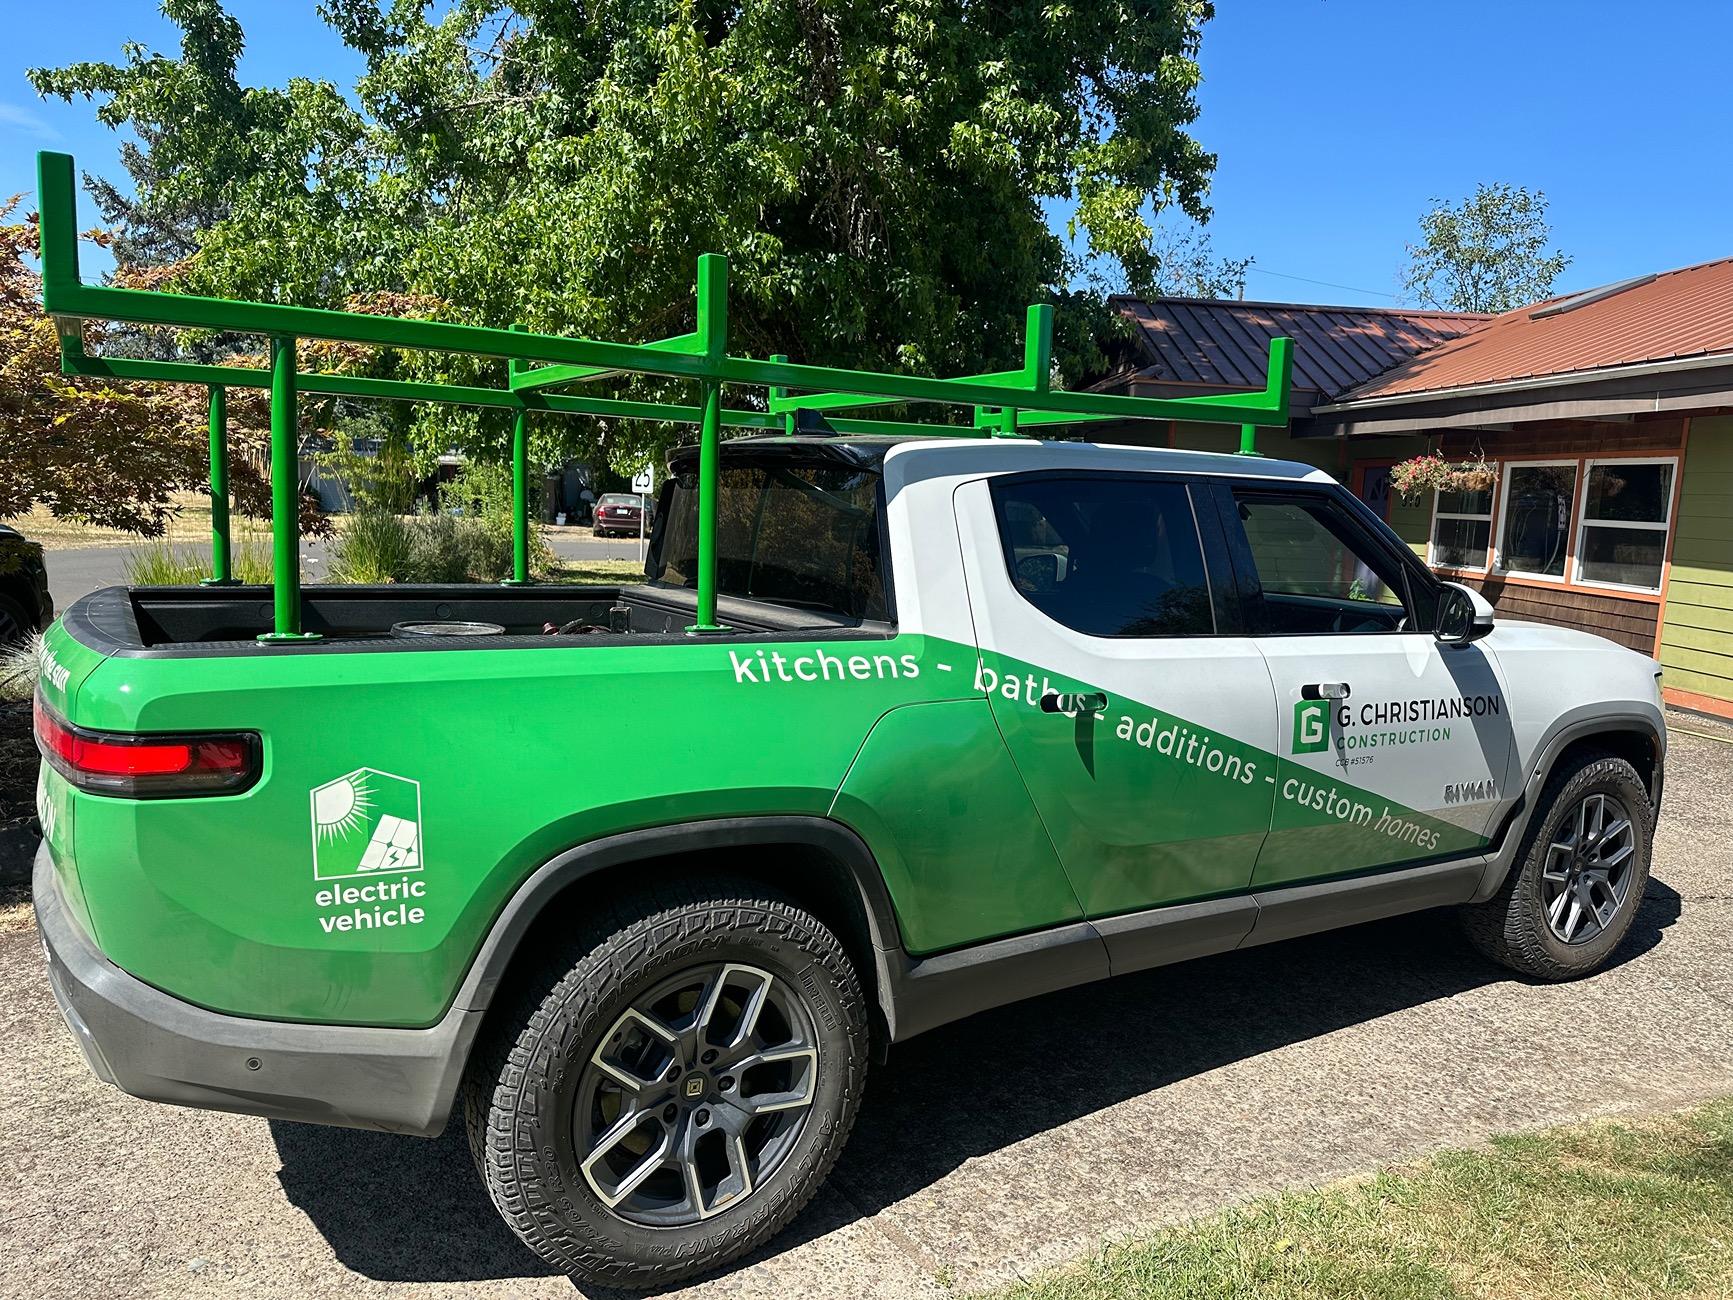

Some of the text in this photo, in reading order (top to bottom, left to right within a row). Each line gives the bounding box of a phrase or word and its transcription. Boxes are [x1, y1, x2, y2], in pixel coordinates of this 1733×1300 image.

[635, 470, 650, 487] 25
[52, 664, 71, 694] sun
[1337, 694, 1500, 728] G. CHRISTIANSON
[729, 650, 920, 684] kitchens
[1115, 712, 1258, 786] additions
[1282, 778, 1373, 828] custom
[1374, 806, 1442, 851] homes
[1336, 727, 1451, 750] CONSTRUCTION
[315, 876, 426, 907] electric
[319, 903, 425, 932] vehicle
